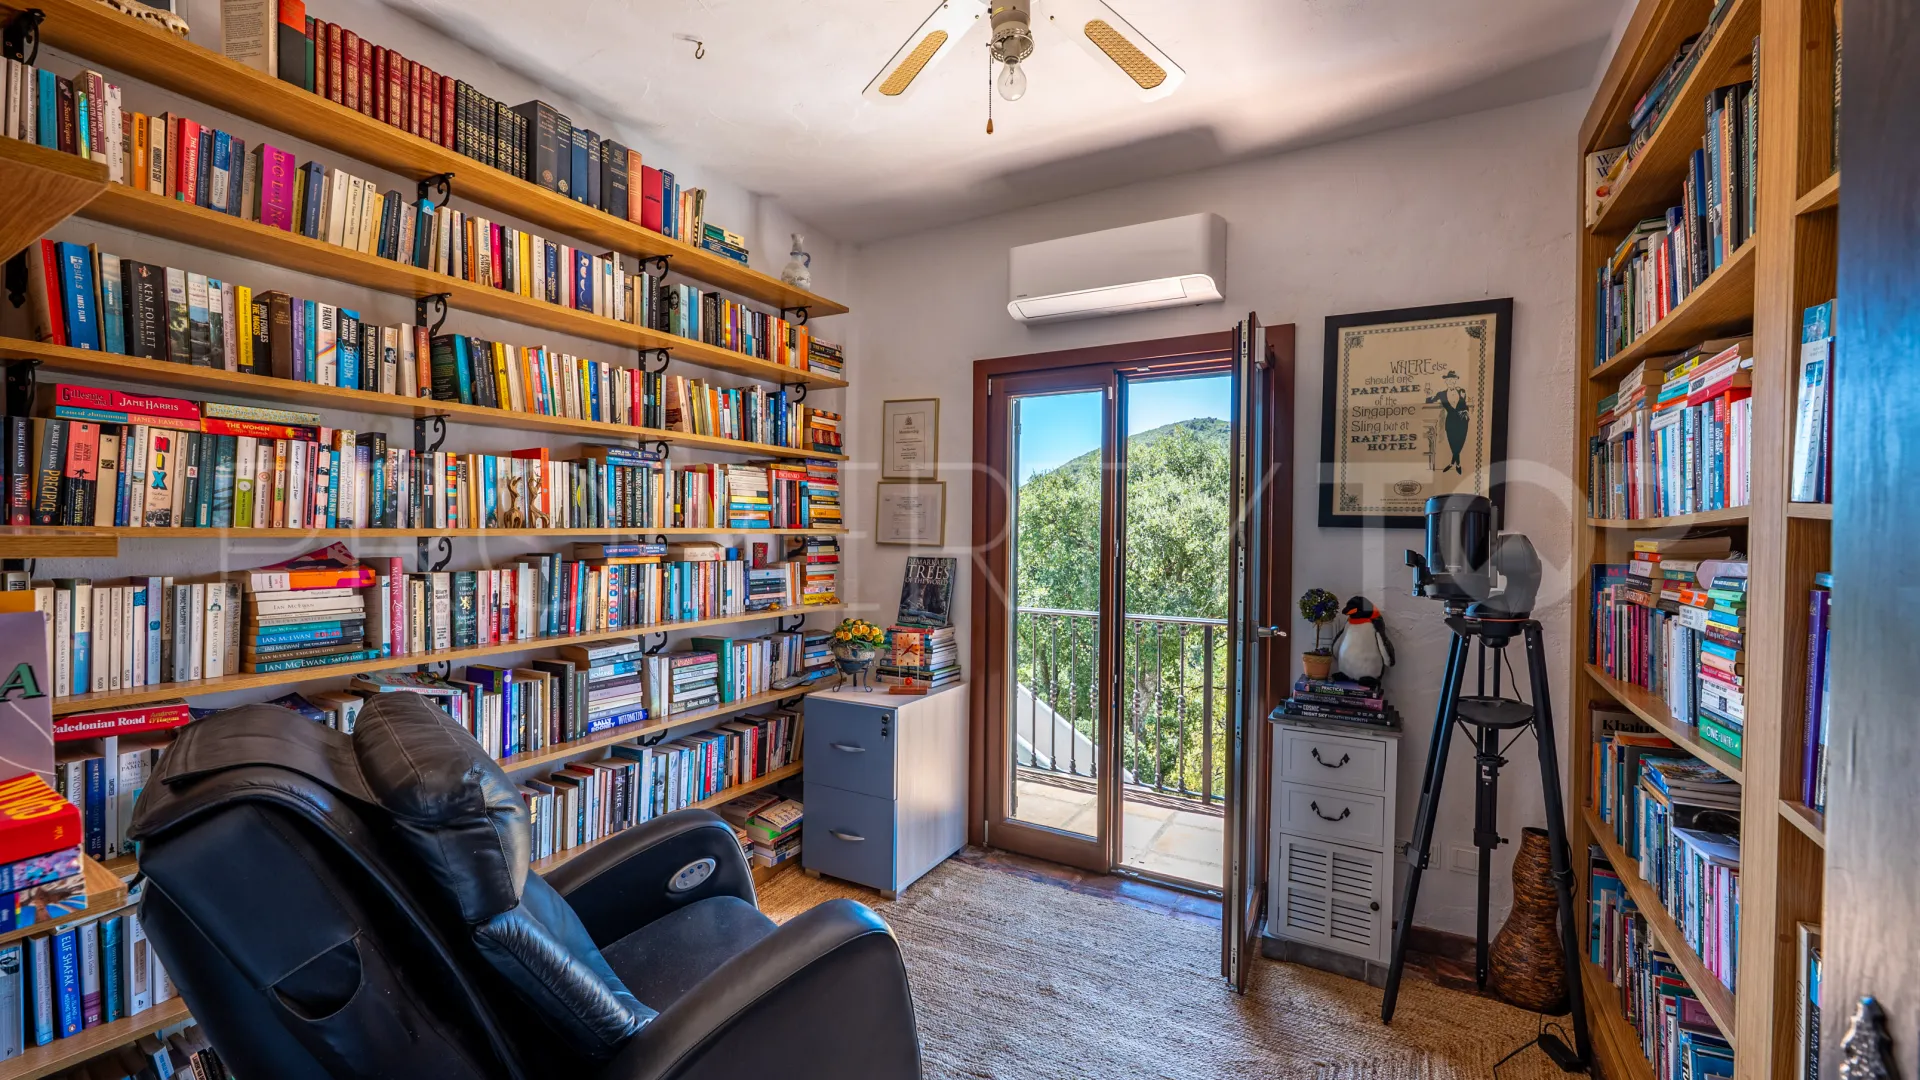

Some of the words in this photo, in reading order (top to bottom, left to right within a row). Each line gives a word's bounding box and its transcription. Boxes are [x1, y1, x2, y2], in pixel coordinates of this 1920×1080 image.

[64, 106, 72, 121] Secret
[1706, 180, 1714, 224] HISTORY
[76, 294, 84, 308] JAMES
[144, 283, 154, 303] KEN
[78, 309, 86, 322] FLINT
[252, 303, 260, 315] THE
[260, 304, 268, 319] JOHN
[145, 306, 156, 348] FOLLETT
[252, 316, 260, 336] MAGUS
[322, 306, 332, 331] FRANZEN
[260, 319, 269, 343] FOWLES
[349, 318, 357, 344] JONATHAN
[1390, 358, 1432, 375] WHERE
[1432, 362, 1448, 372] else
[1364, 376, 1394, 385] should
[1396, 375, 1414, 384] one
[1350, 384, 1420, 396] PARTAKE
[119, 397, 144, 408] JANE
[145, 398, 179, 411] HARRIS
[1374, 395, 1383, 406] of
[1385, 396, 1398, 406] the
[1352, 406, 1416, 420] Singapore
[18, 421, 26, 444] ROBERT
[226, 422, 240, 430] THE
[242, 423, 270, 432] WOMEN
[1351, 420, 1381, 433] Sling
[1383, 421, 1398, 432] but
[1400, 421, 1409, 430] at
[51, 424, 60, 447] ROBERT
[1351, 434, 1418, 443] RAFFLES
[1807, 396, 1820, 476] CLINICAL
[74, 442, 83, 462] HELLER
[83, 444, 92, 462] JOSEPH
[1367, 443, 1417, 451] HOTEL
[18, 444, 26, 468] HARRIS
[49, 447, 58, 469] HARRIS
[151, 436, 170, 490] NIX
[330, 460, 338, 477] NICK
[14, 472, 30, 508] POMPEII
[40, 469, 61, 512] PRECIPICE
[75, 489, 84, 510] CLOSING
[329, 488, 337, 517] HORNBY
[907, 565, 950, 580] TREES
[232, 601, 240, 620] FRANK
[278, 634, 311, 642] McEWAN
[264, 664, 282, 672] IAN
[285, 658, 326, 669] McEWAN
[331, 654, 362, 662] SATURDAY
[150, 709, 179, 719] Andrew
[1303, 704, 1320, 712] COSMIC
[118, 715, 146, 726] Road
[590, 723, 616, 733] ROONEY
[618, 710, 644, 724] INTERMEZZO
[592, 718, 613, 728] SALLY
[61, 936, 72, 952] ELIF
[87, 943, 95, 960] Shields
[62, 953, 74, 987] SHAFAK
[1796, 979, 1805, 1044] Gandhi
